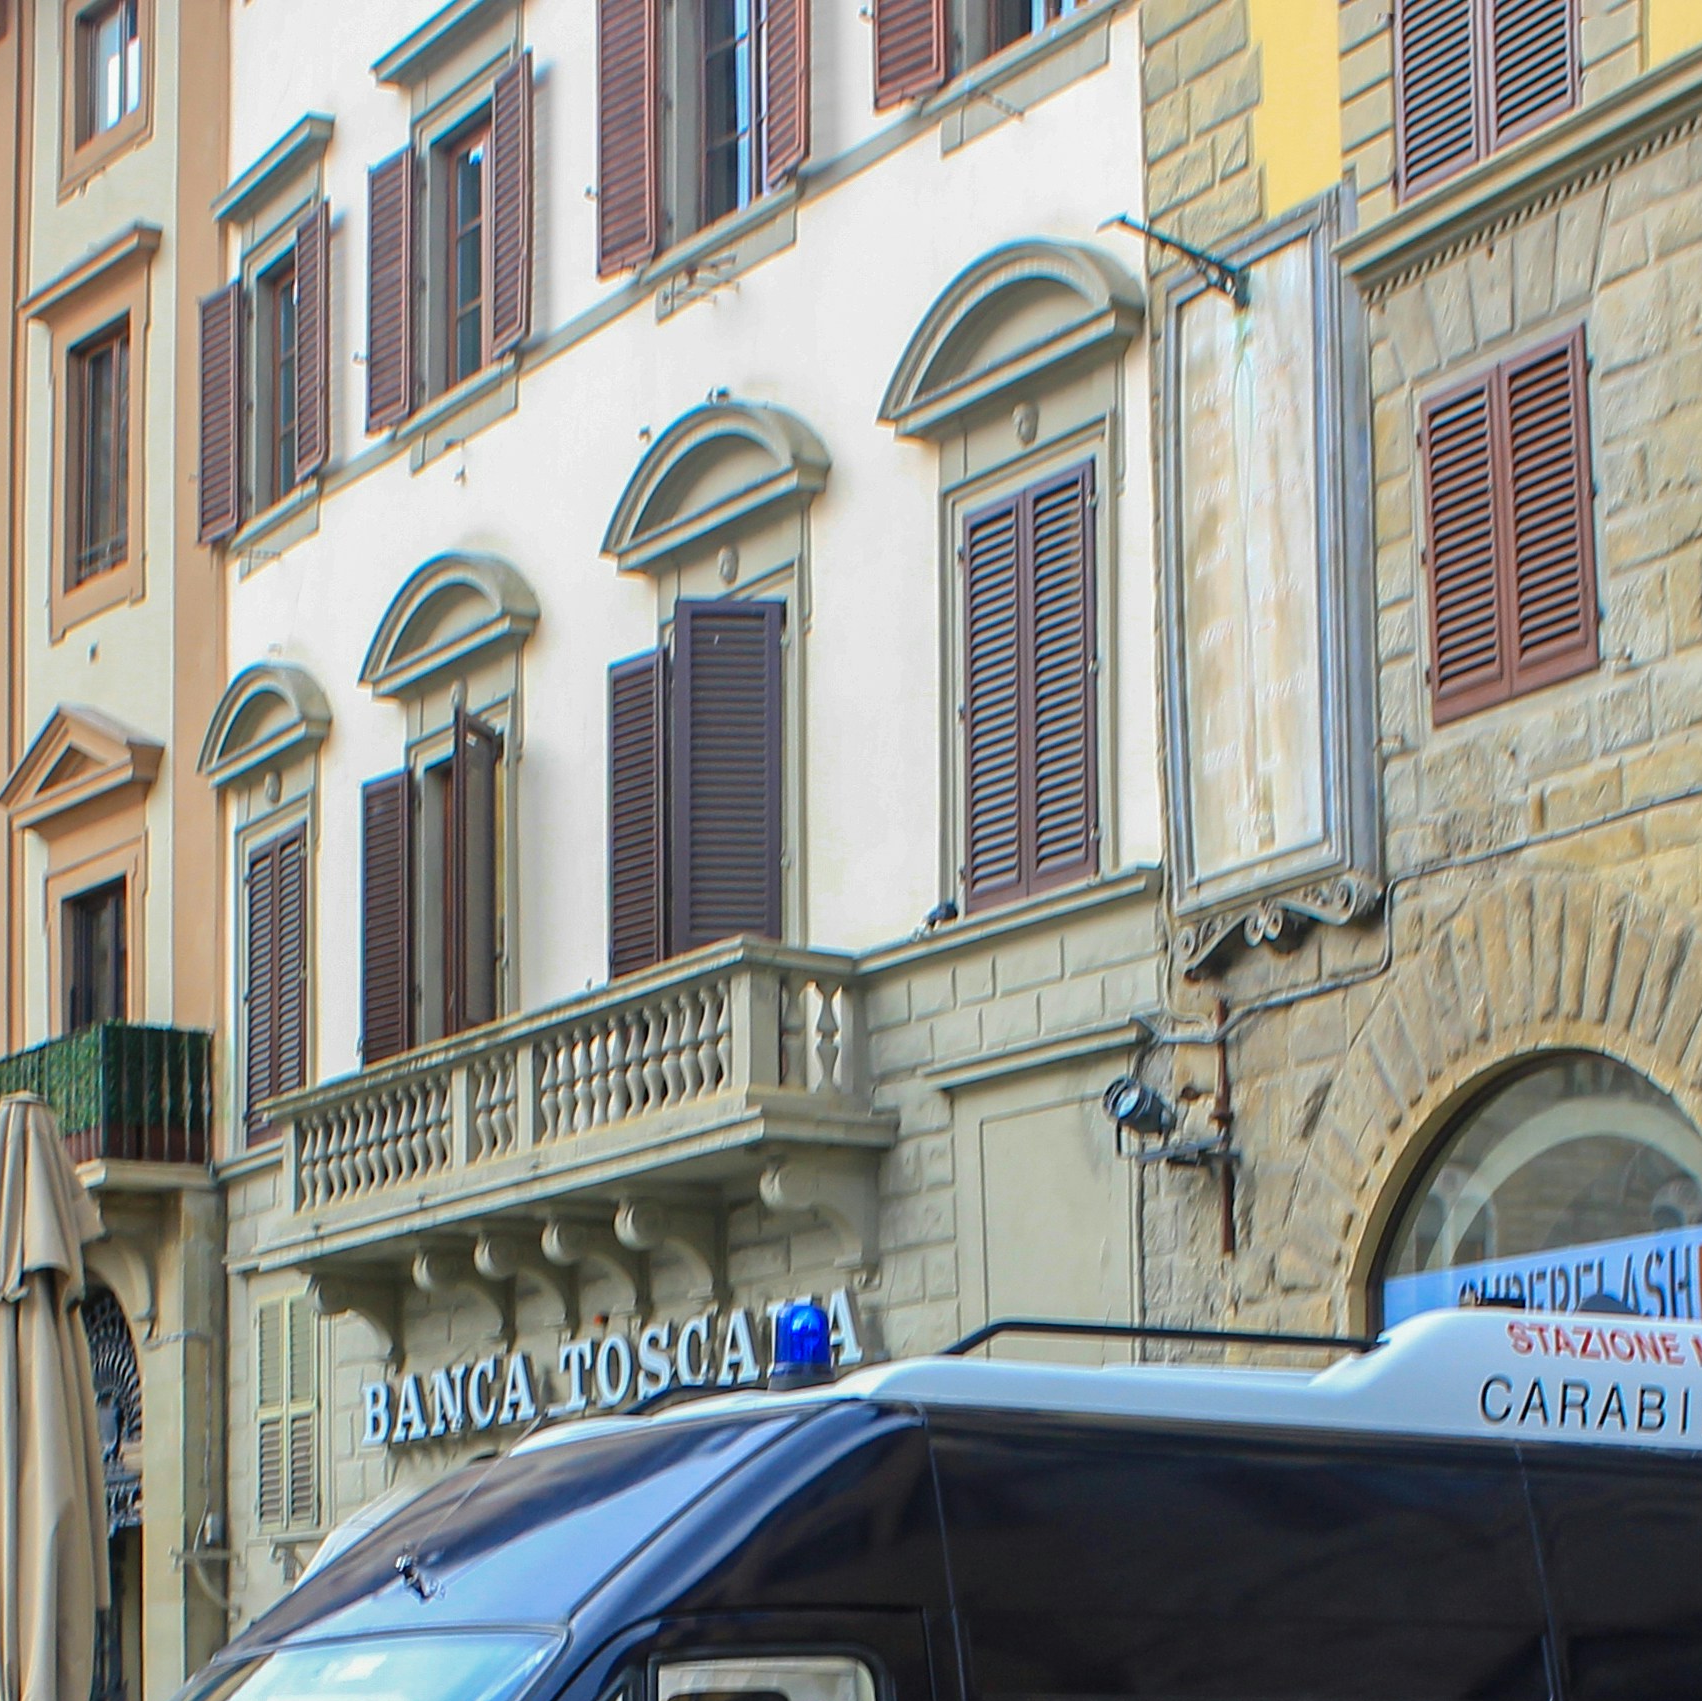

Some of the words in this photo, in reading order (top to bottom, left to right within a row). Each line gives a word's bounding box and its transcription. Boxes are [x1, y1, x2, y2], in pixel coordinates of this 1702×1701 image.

[360, 1351, 538, 1446] BANCA
[544, 1287, 865, 1418] TOSCAA
[1506, 1319, 1687, 1367] STAZIONE
